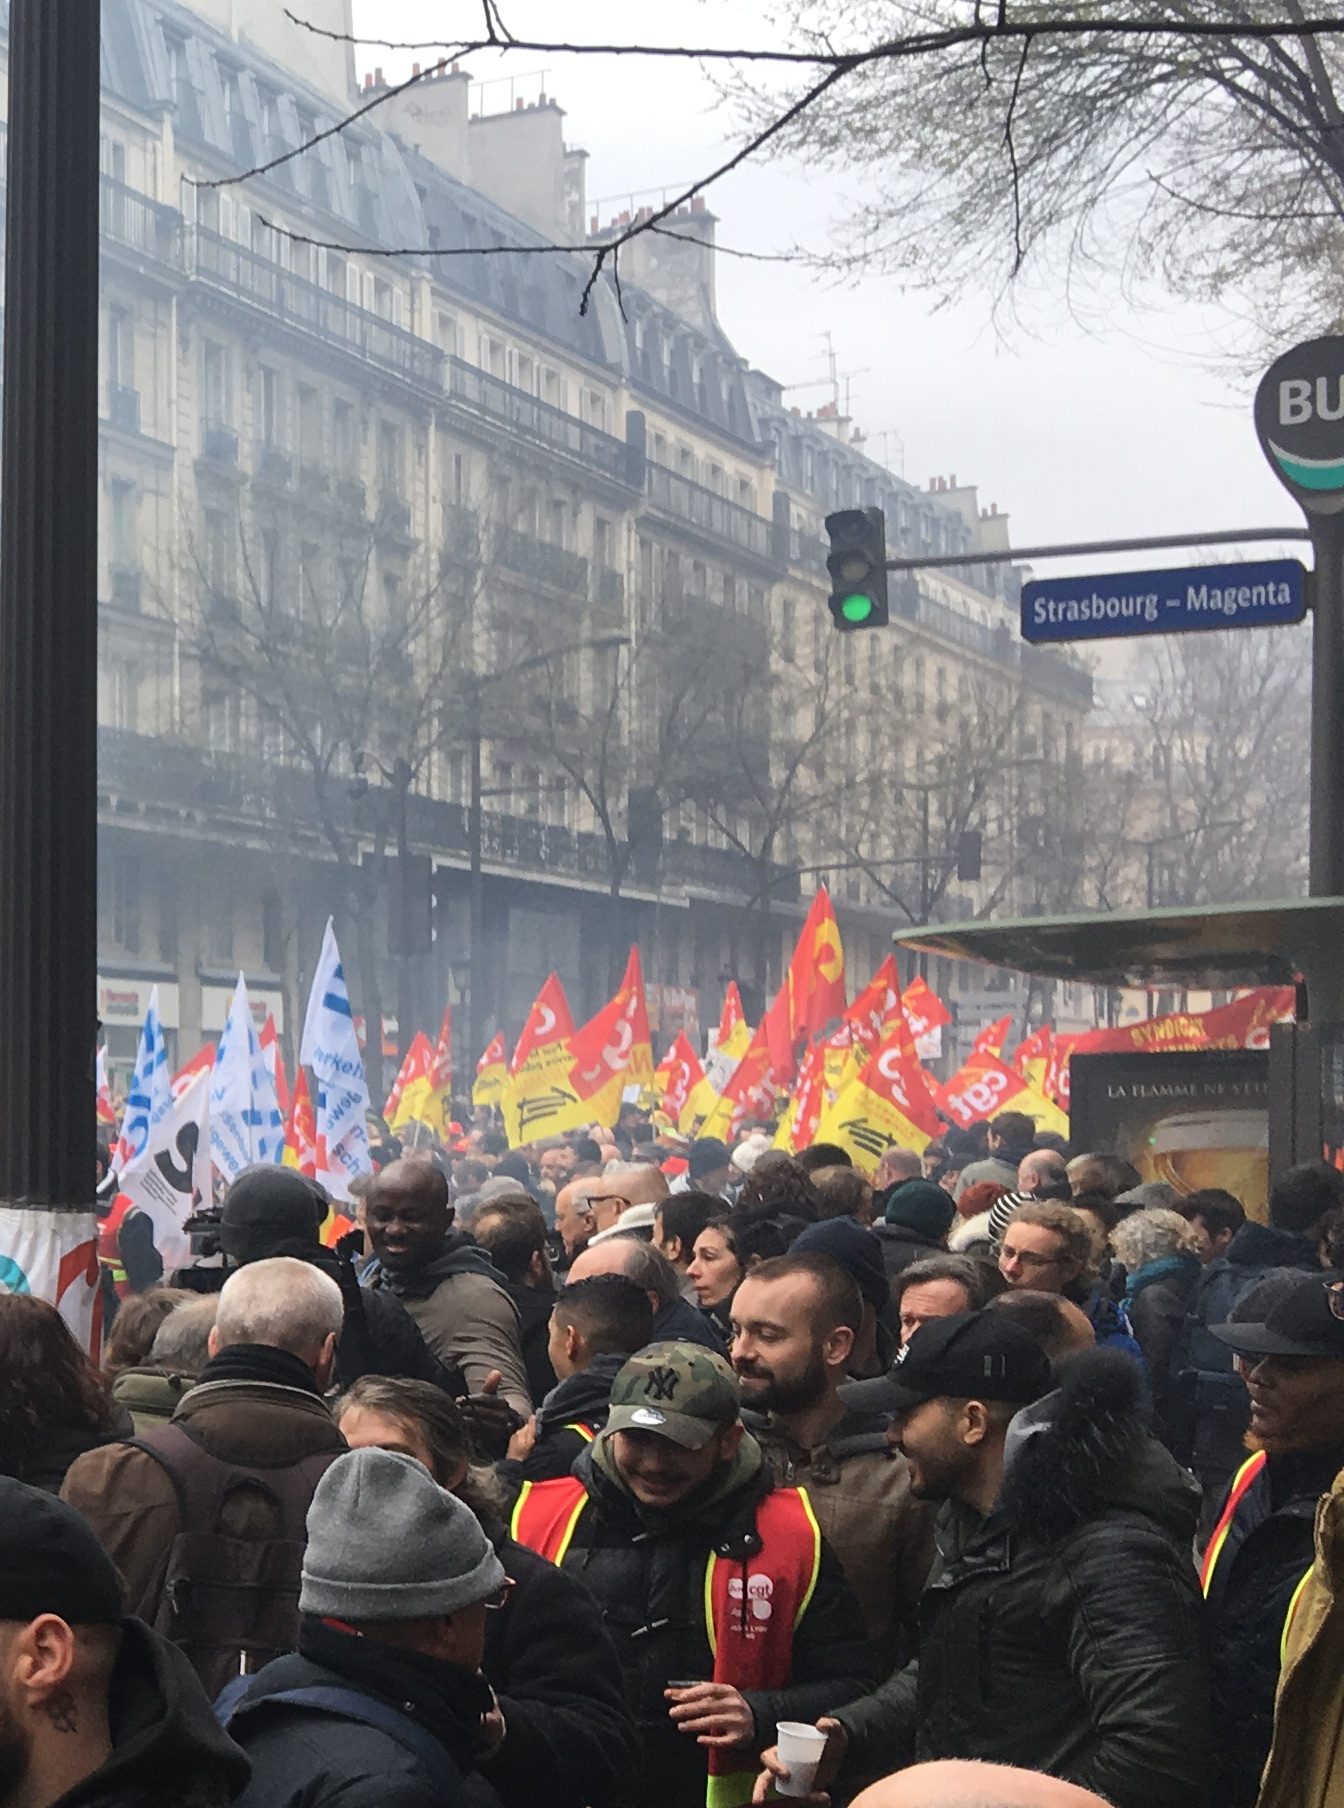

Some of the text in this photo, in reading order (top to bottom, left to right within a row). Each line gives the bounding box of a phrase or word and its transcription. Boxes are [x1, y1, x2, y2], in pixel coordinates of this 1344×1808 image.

[1278, 374, 1344, 426] BU
[1033, 592, 1160, 626] Strasbourg
[1186, 580, 1291, 617] Magenta
